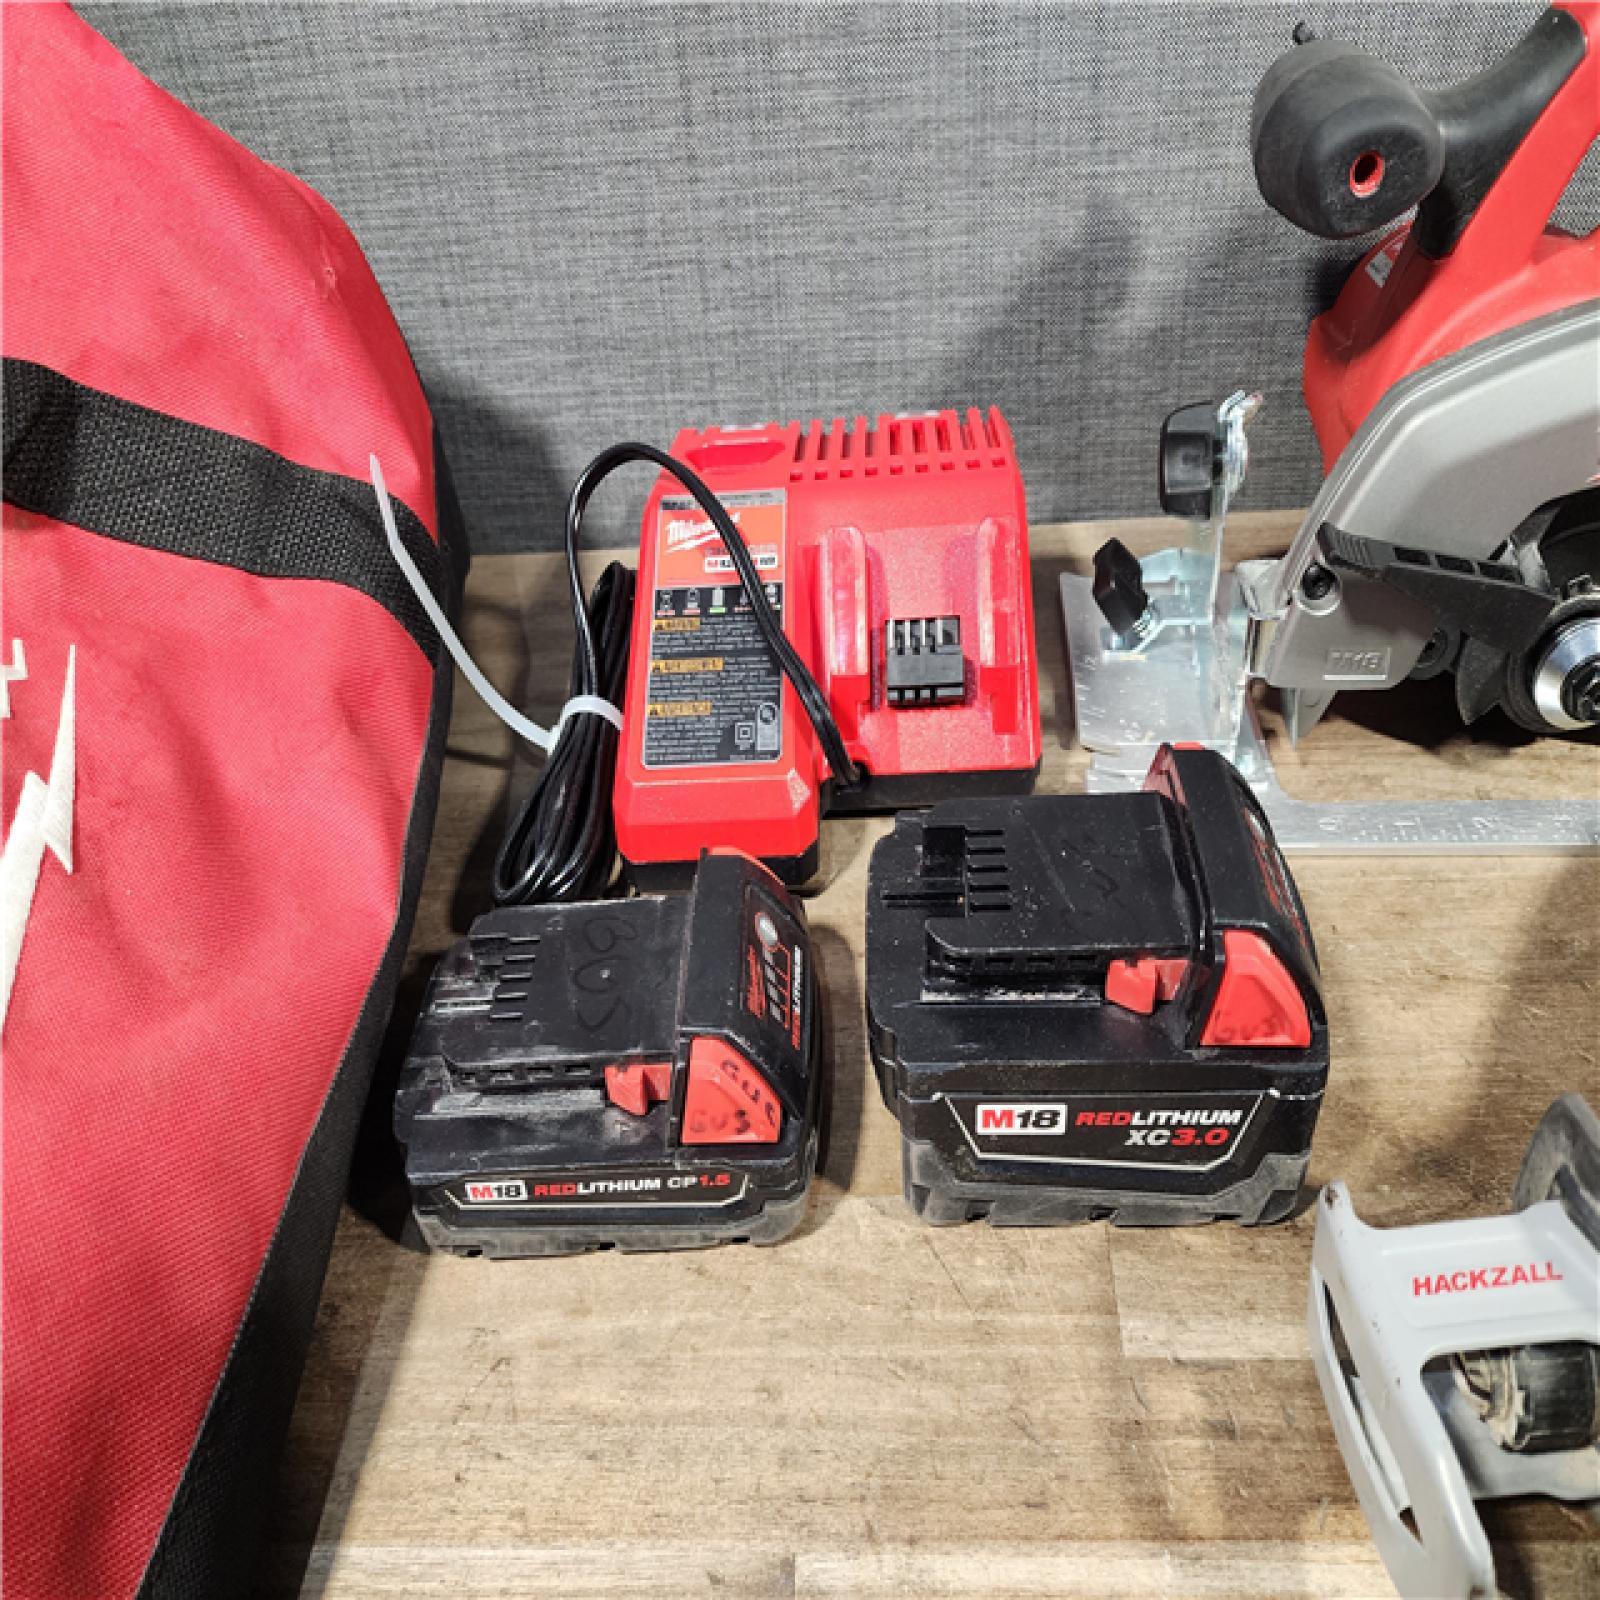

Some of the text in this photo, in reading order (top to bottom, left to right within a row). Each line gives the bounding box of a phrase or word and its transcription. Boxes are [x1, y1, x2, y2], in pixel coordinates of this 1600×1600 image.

[982, 1109, 1243, 1129] M18 REDLITHIUM
[1124, 1129, 1230, 1146] XC3.0
[469, 1184, 521, 1199] M18
[534, 1177, 661, 1196] REDLITHIUM
[1412, 1260, 1564, 1297] HACKZALL
